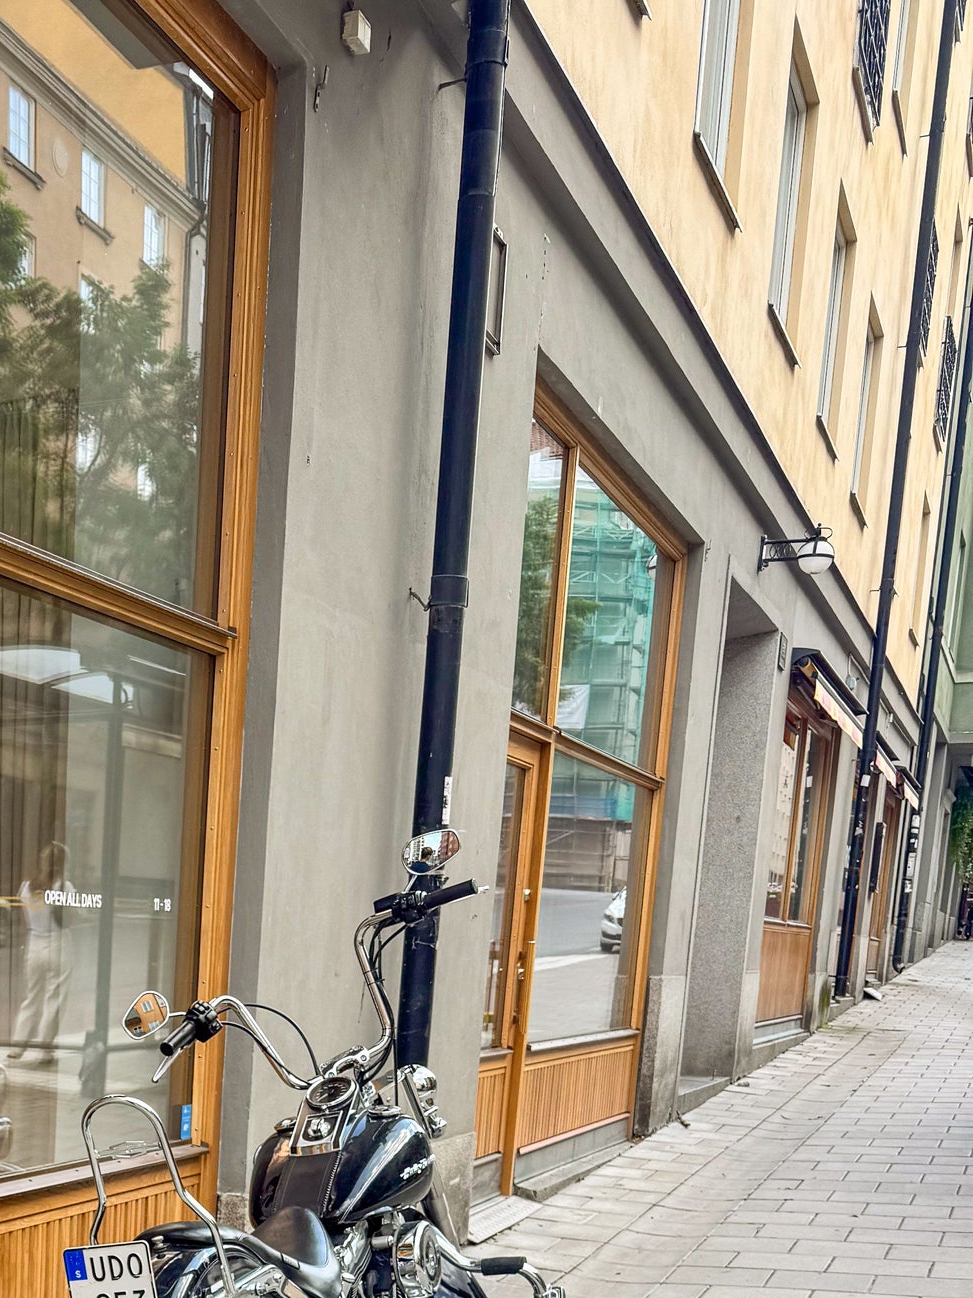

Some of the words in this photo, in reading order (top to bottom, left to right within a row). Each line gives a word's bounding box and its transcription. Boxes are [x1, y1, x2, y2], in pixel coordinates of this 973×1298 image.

[44, 890, 66, 906] OPEN
[66, 892, 81, 908] ALL
[81, 893, 102, 908] DAYS
[75, 1270, 82, 1279] S
[90, 1253, 143, 1282] UDO
